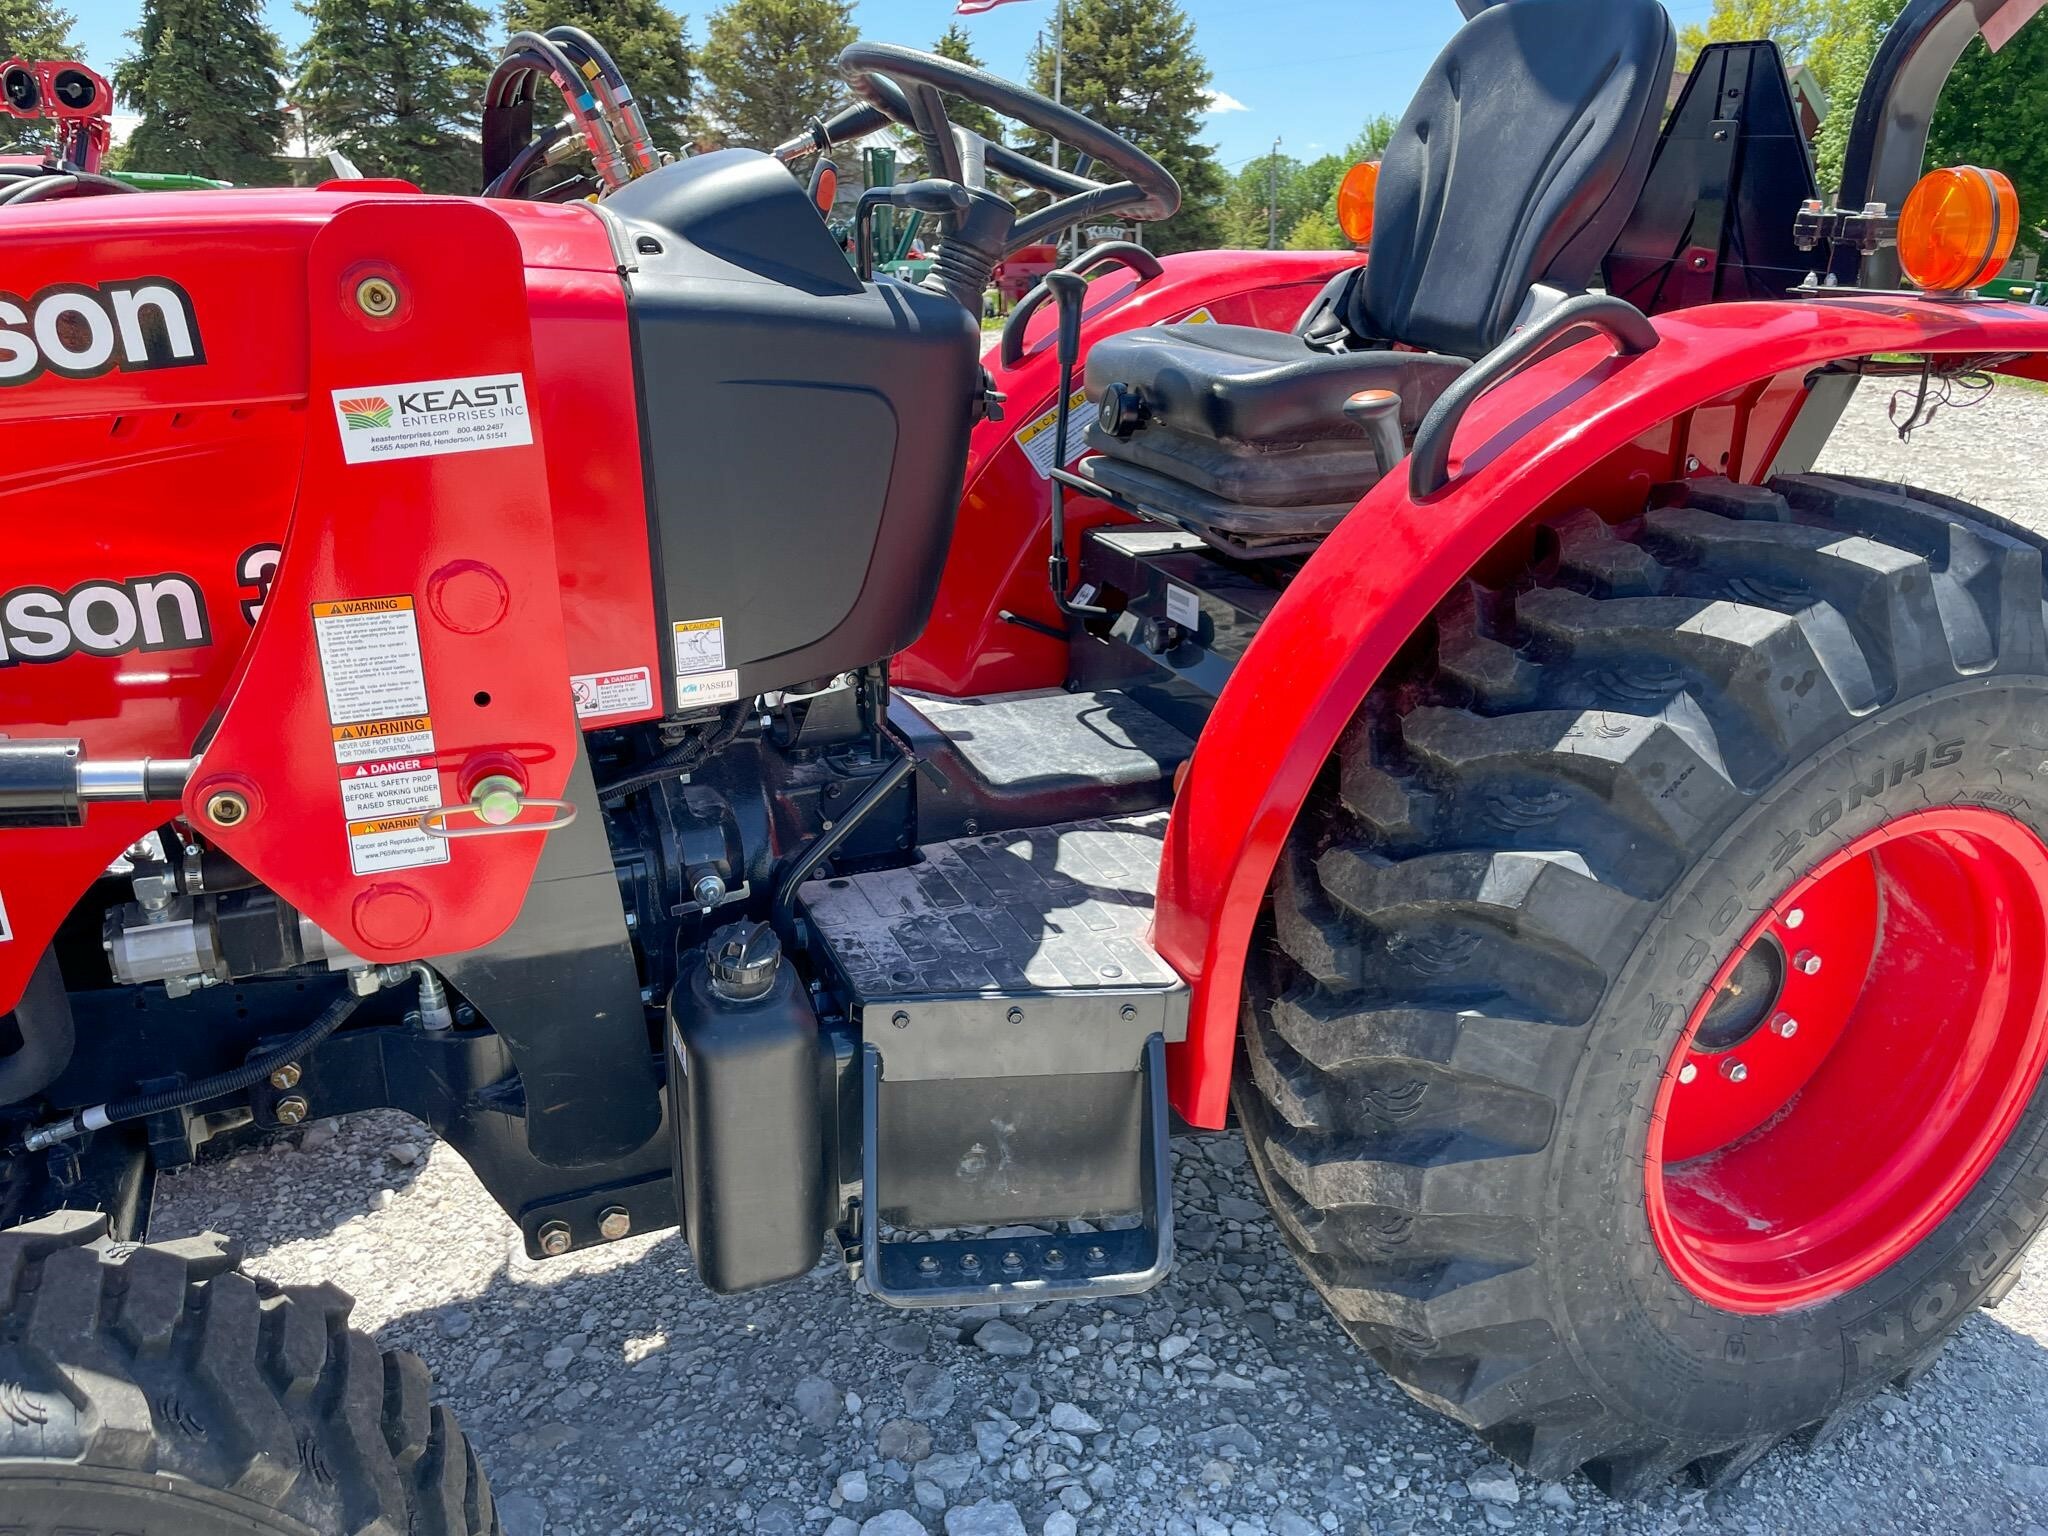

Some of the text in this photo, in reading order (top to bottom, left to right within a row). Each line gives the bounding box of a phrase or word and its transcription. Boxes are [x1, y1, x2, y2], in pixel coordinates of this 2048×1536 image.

[398, 384, 518, 414] KEAST
[402, 406, 524, 427] ENTERPRISES INC
[371, 429, 449, 443] keastenterprises.com
[371, 444, 393, 452] 45565
[395, 443, 418, 451] Aspen
[434, 436, 476, 446] Henderson,
[344, 600, 397, 613] WARNING
[611, 674, 639, 683] DANGER
[700, 680, 732, 691] PASSED
[356, 720, 425, 736] WARNING
[339, 742, 358, 750] NEVER
[359, 740, 371, 748] USE
[372, 737, 391, 745] FRONT
[407, 734, 430, 742] LOADER
[354, 747, 377, 756] TOWING
[371, 760, 421, 774] DANGER
[348, 782, 378, 791] INSTALL
[381, 778, 409, 787] SAFETY
[345, 785, 438, 802] BEFORE WORKING UNDER
[357, 802, 384, 811] RAISED
[387, 796, 429, 807] STRUCTURE
[378, 818, 421, 830] WARNIN
[355, 841, 375, 850] Cancer
[377, 839, 388, 847] and
[390, 836, 425, 846] Reproductive
